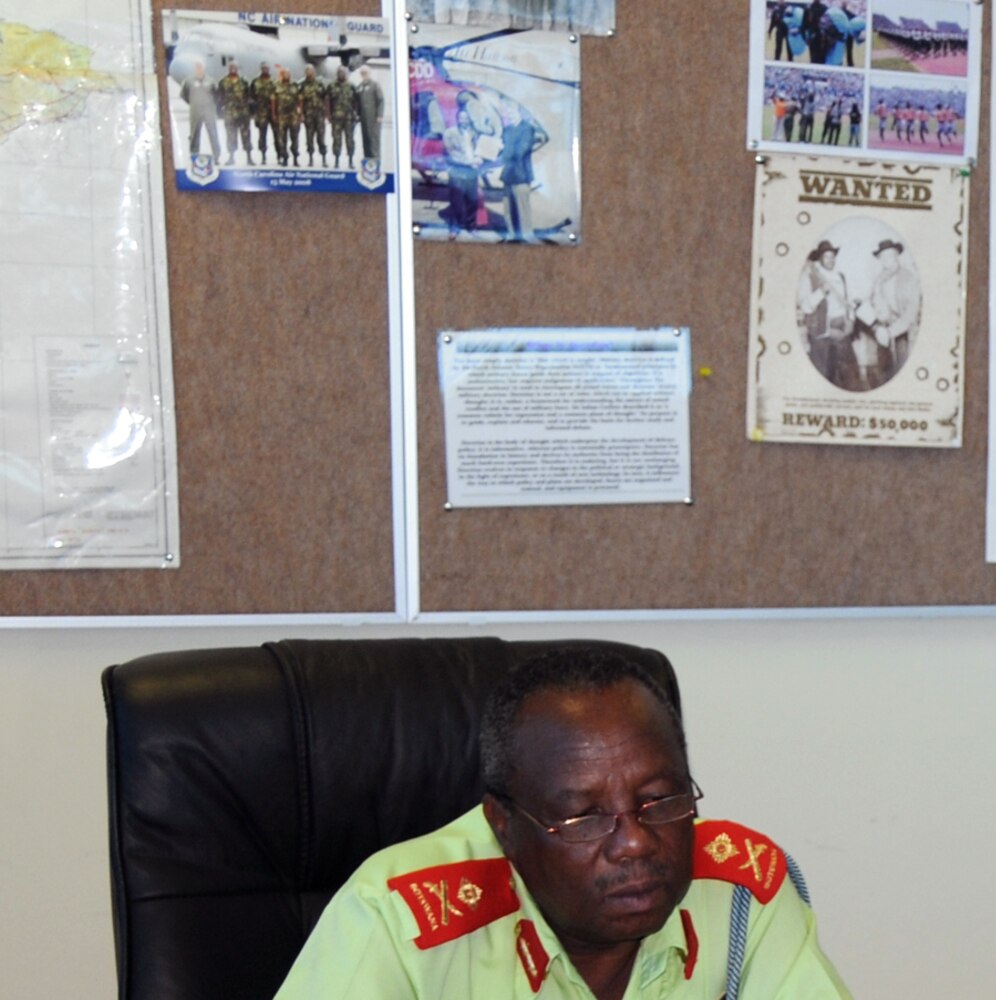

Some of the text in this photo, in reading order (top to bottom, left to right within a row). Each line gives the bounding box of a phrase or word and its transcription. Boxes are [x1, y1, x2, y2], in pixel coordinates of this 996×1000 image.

[238, 11, 256, 23] NC
[261, 13, 280, 25] AIR
[347, 21, 385, 33] GUARD
[801, 176, 932, 203] WANTED
[782, 412, 928, 432] REWARD: $50,000
